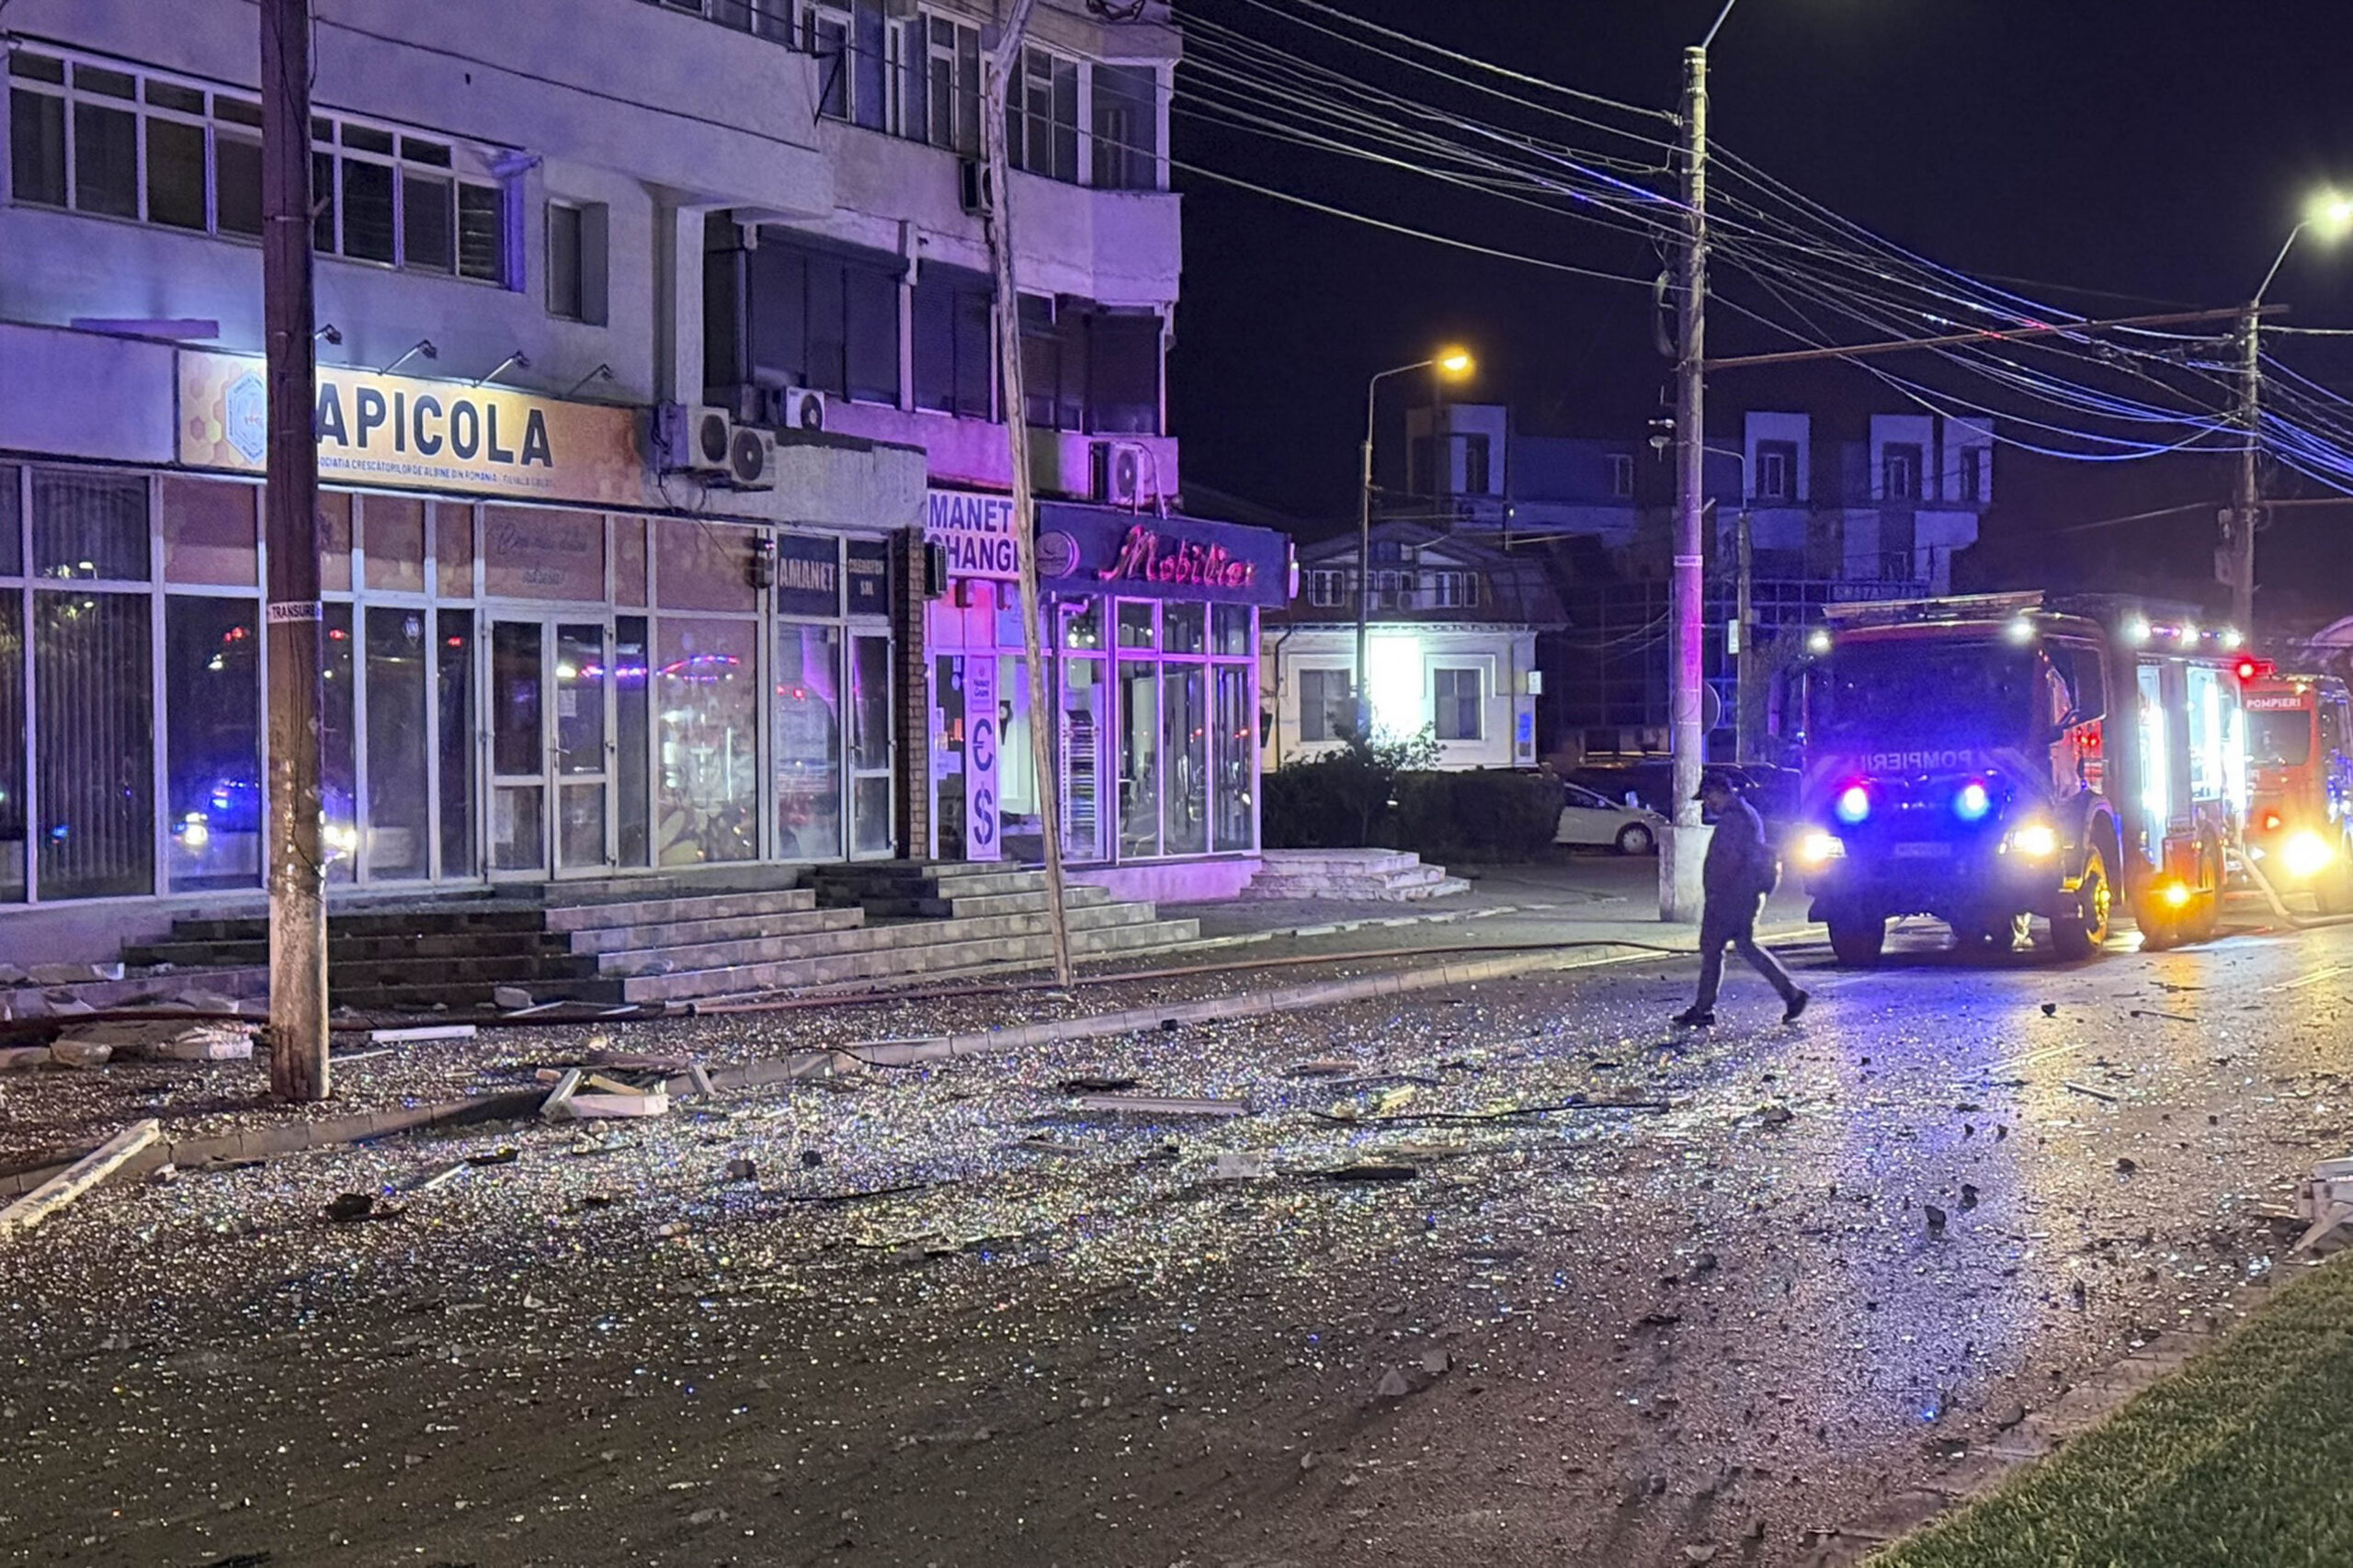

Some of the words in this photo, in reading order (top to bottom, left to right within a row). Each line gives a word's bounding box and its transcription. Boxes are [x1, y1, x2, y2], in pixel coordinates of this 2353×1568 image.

[317, 382, 553, 468] APICOLA
[929, 493, 1013, 533] MANET
[929, 533, 1019, 573] HANG
[779, 557, 835, 592] AMANET
[2245, 698, 2302, 709] POMPIERI
